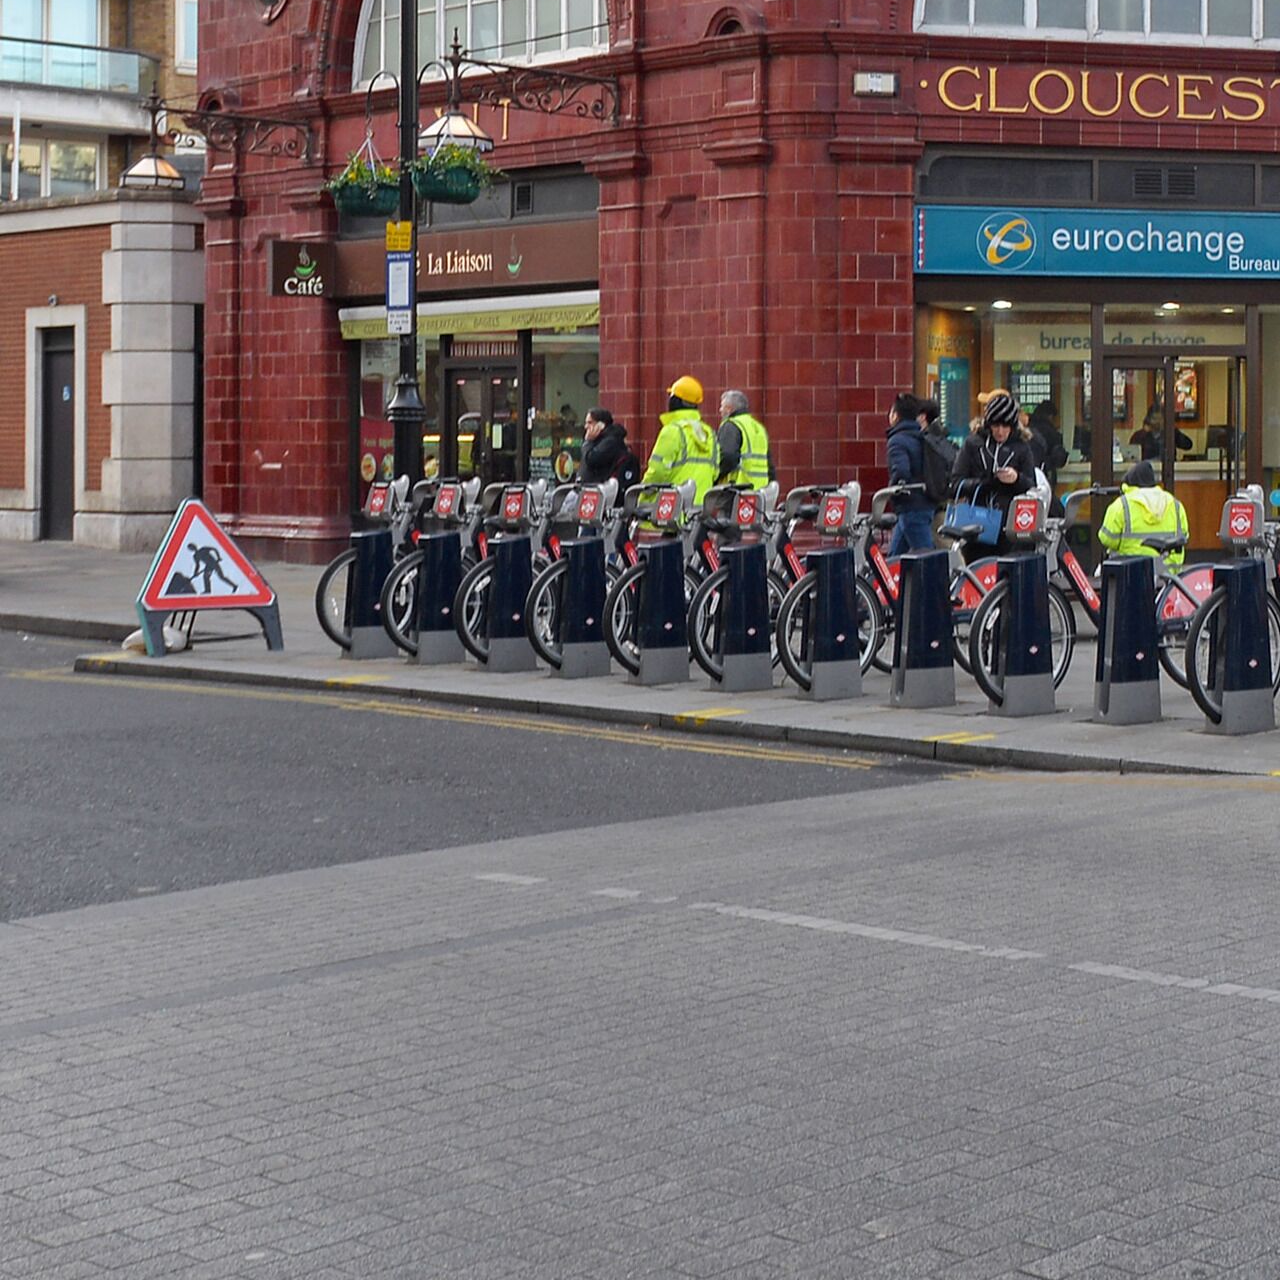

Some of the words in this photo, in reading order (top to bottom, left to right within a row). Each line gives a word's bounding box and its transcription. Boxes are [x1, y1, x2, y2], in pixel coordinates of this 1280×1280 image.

[1052, 222, 1245, 261] eurochange
[428, 253, 443, 276] La
[447, 250, 493, 275] Liaison
[1229, 255, 1280, 272] Bureau
[284, 276, 323, 295] Café
[1040, 331, 1091, 351] burea
